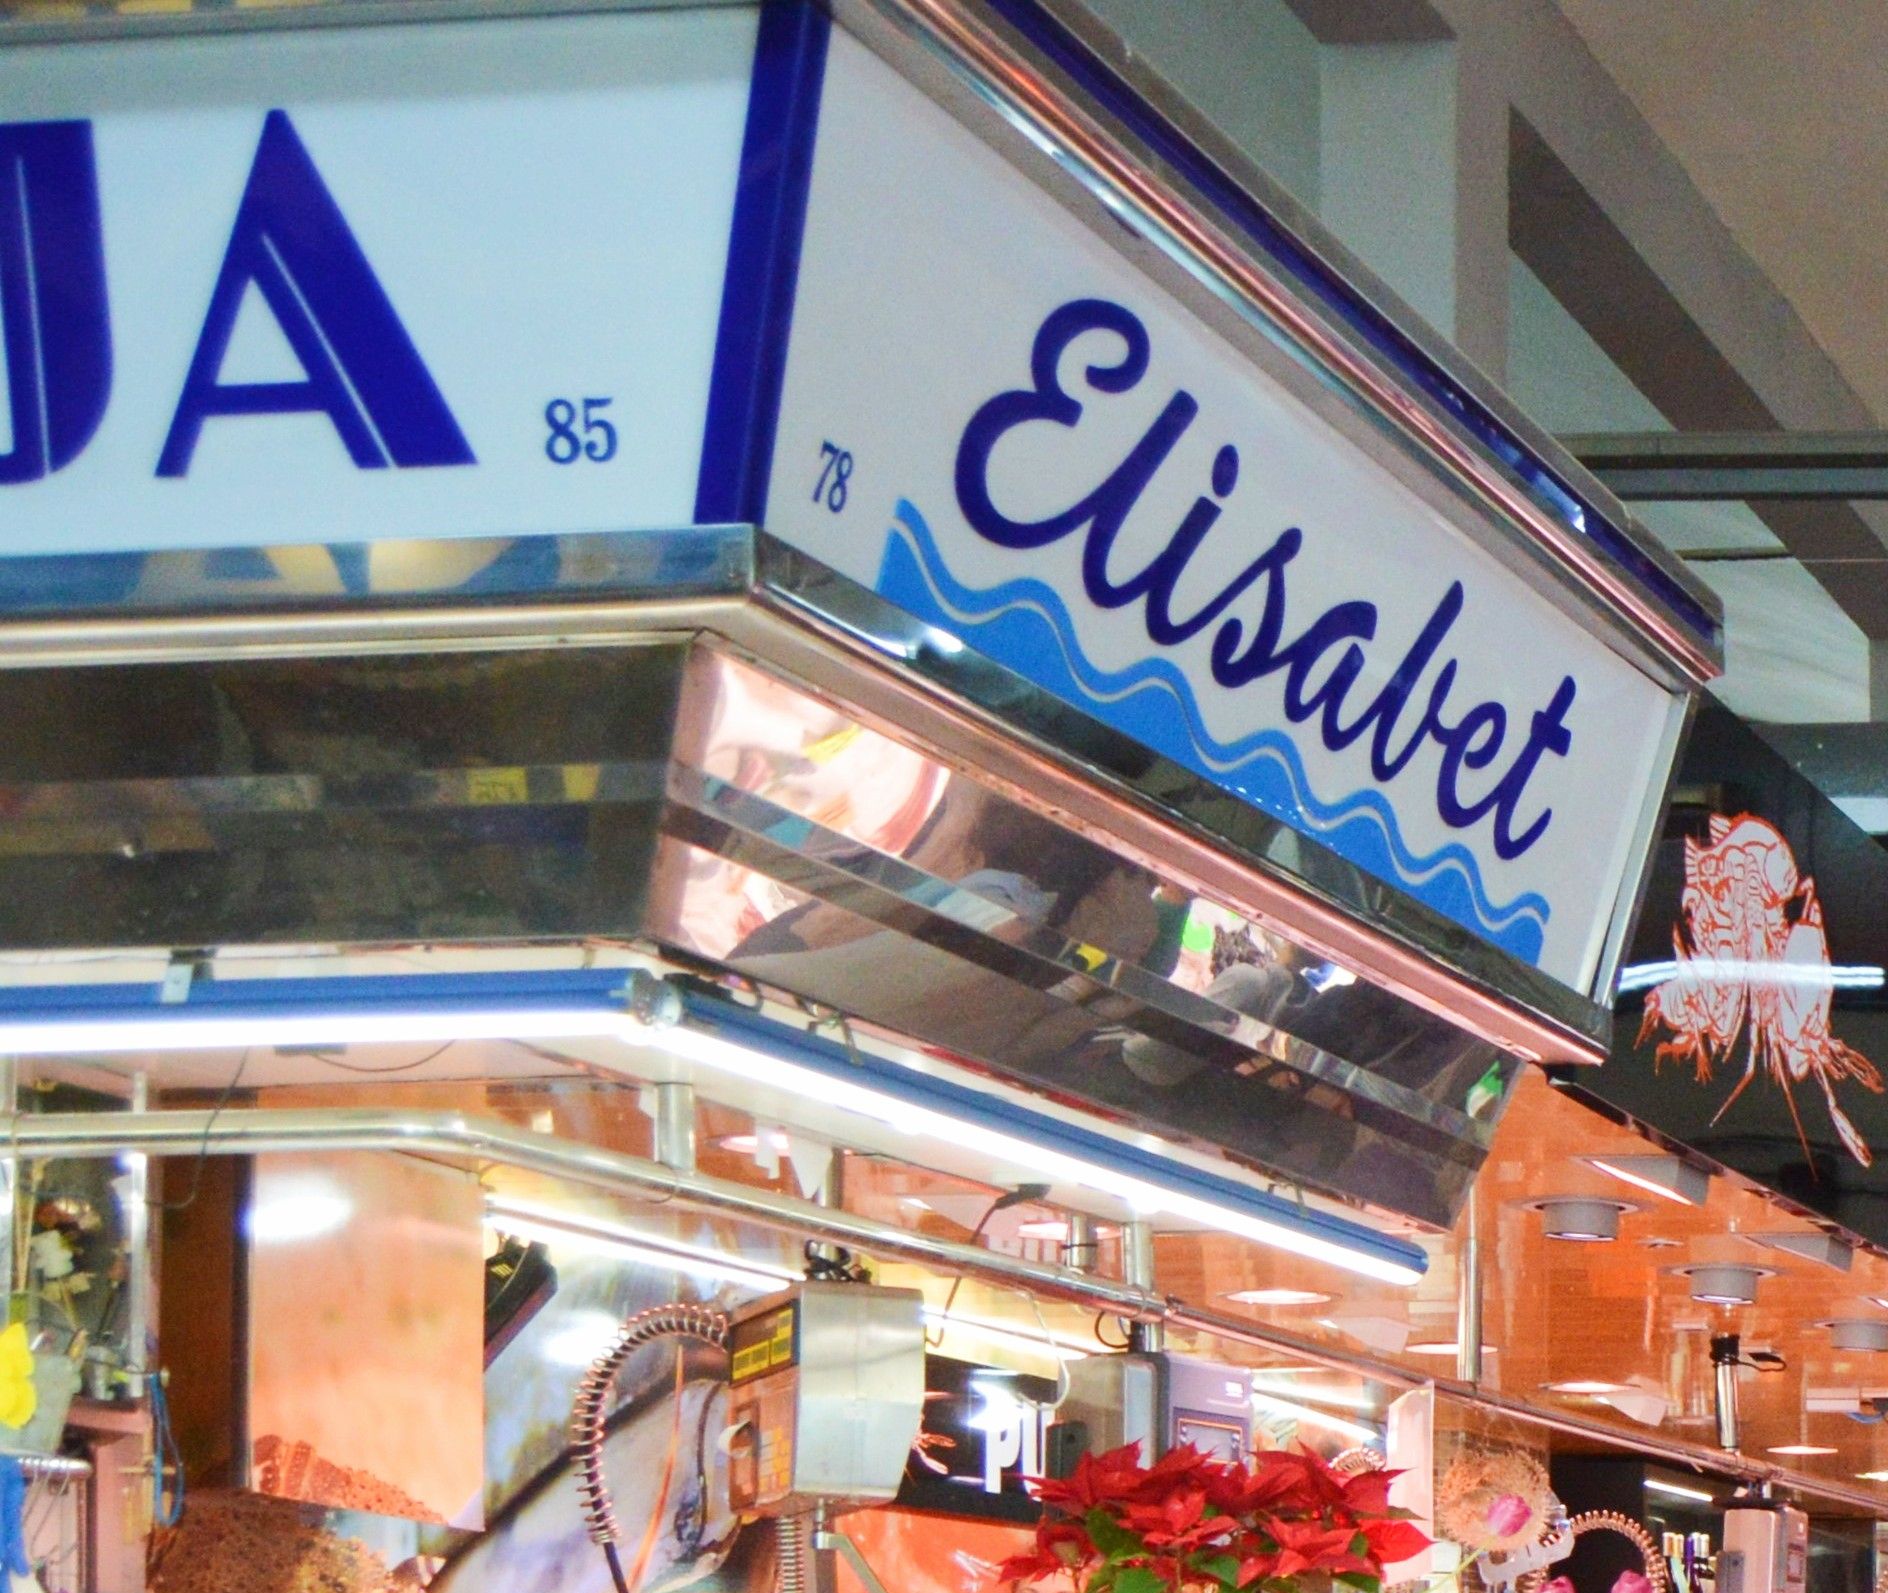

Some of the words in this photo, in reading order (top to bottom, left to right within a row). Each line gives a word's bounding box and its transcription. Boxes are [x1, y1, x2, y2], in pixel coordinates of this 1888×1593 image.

[545, 398, 618, 464] 85
[811, 441, 854, 513] 78
[954, 298, 1577, 860] Elisabet
